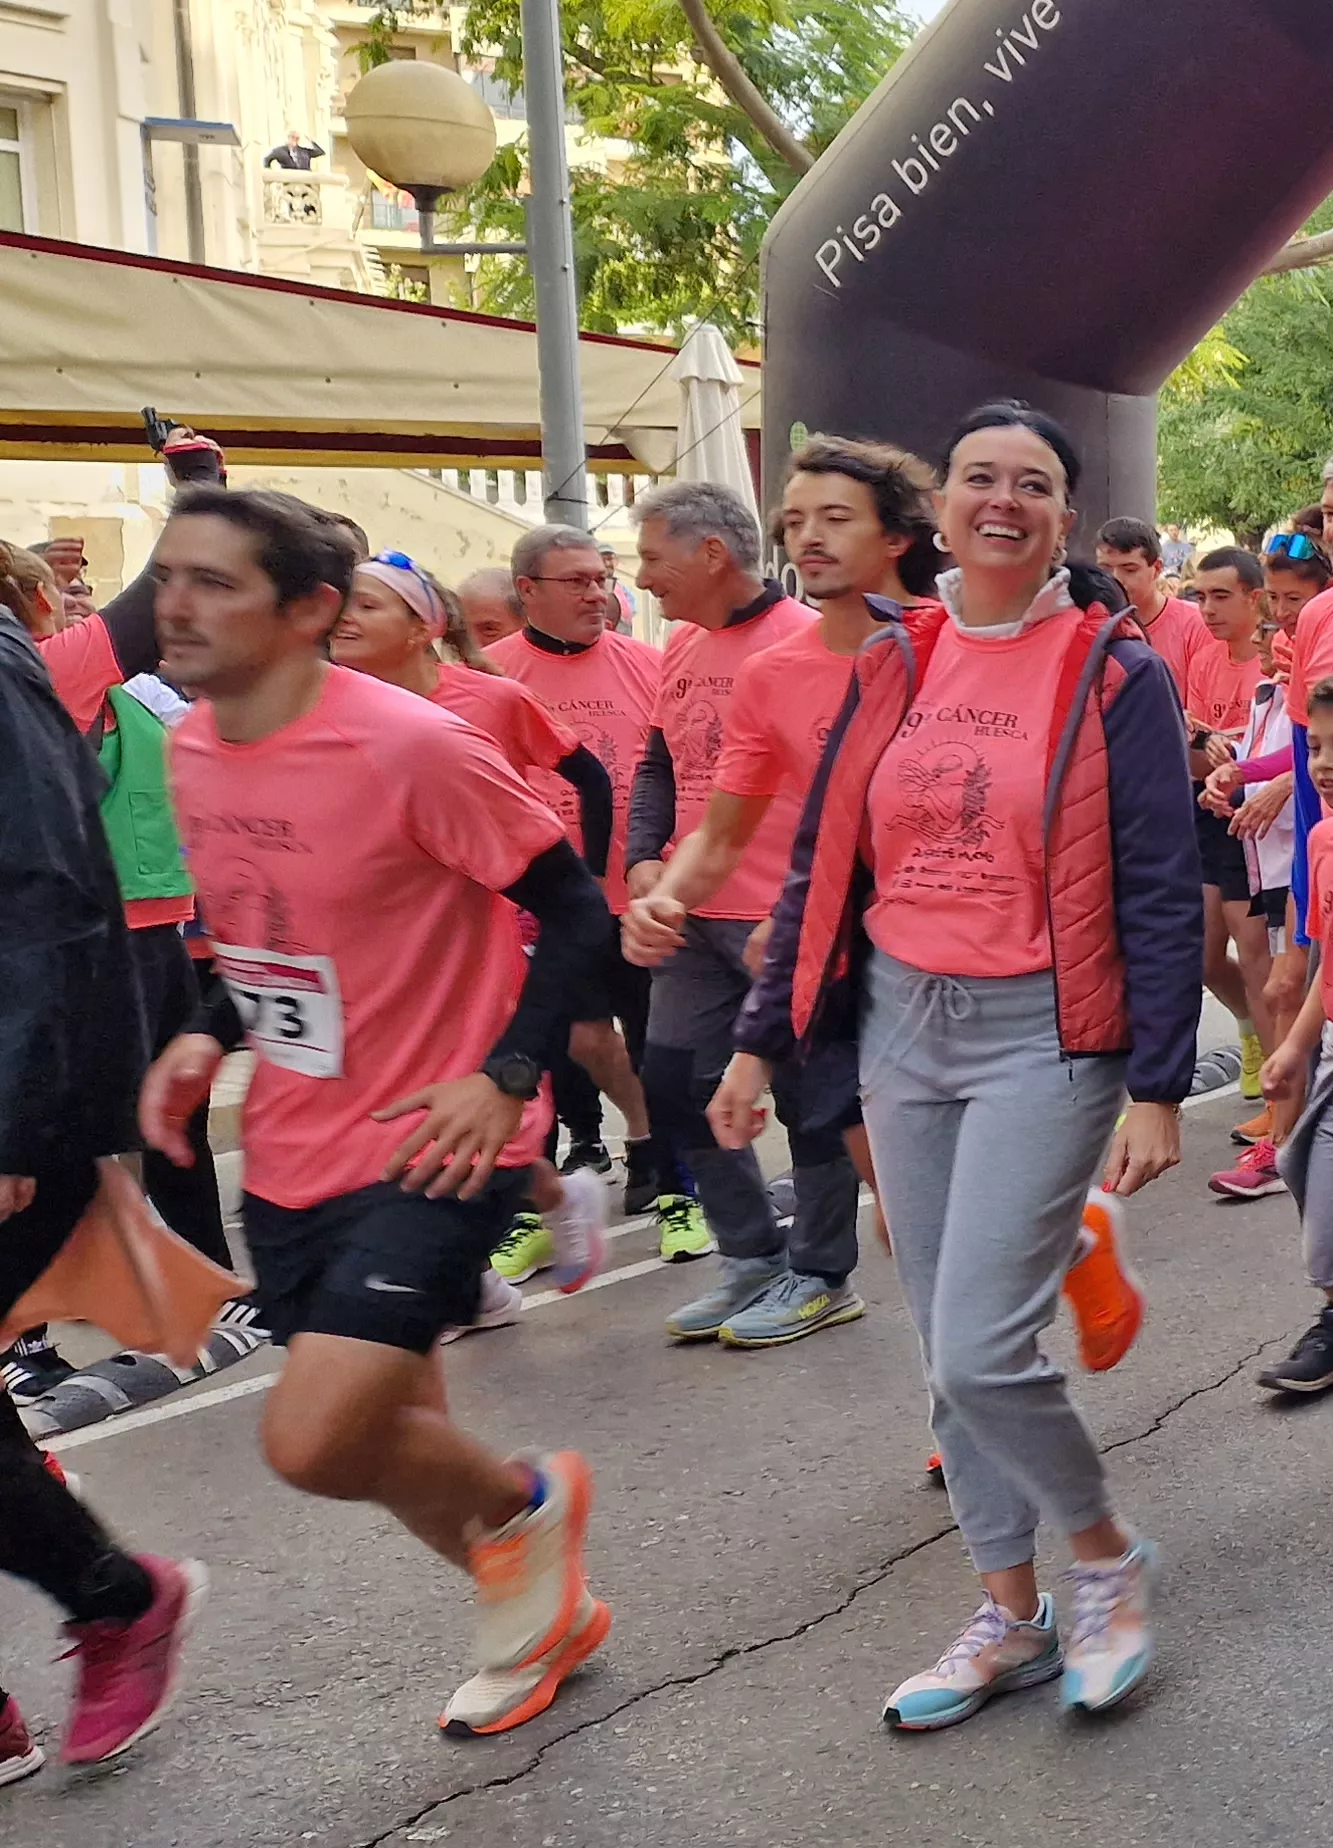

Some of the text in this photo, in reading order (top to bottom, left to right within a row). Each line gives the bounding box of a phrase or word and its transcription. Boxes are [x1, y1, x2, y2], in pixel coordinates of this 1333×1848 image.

[815, 0, 1061, 287] Pisa bien, vive
[936, 704, 1018, 729] CÁNCER
